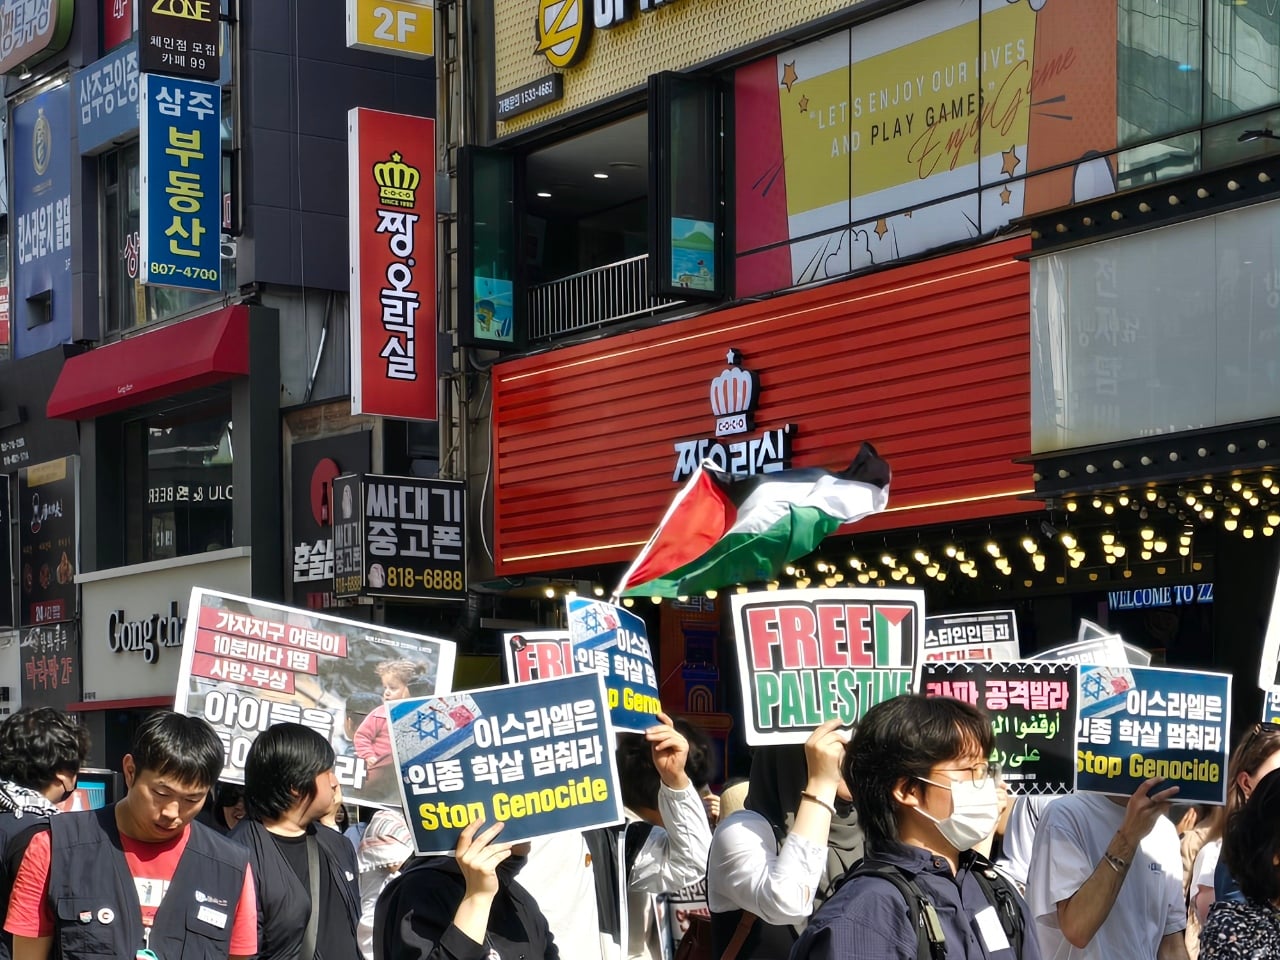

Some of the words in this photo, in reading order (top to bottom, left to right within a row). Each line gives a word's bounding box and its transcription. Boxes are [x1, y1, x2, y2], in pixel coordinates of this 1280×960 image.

[373, 7, 417, 43] 2F
[162, 53, 186, 68] 카페
[192, 42, 216, 57] 모집
[155, 86, 215, 121] 삼주
[869, 75, 925, 113] ENJOY
[932, 61, 968, 92] OUR
[871, 113, 914, 146] PLAY
[163, 126, 207, 258] 부동산
[151, 262, 219, 282] 807-4700
[366, 483, 461, 523] 싸대기
[367, 521, 463, 561] 중고폰
[387, 566, 463, 591] 818-6888
[1108, 586, 1173, 611] WELCOME
[1174, 584, 1195, 605] TO
[108, 609, 160, 664] Gong
[215, 611, 286, 642] 가자지구
[288, 626, 340, 654] 어린이
[746, 603, 873, 670] FREE
[212, 634, 285, 667] 10분마다
[285, 650, 311, 671] 1명
[613, 654, 644, 686] 학살
[1125, 688, 1223, 720] 이스라엘은
[472, 699, 599, 749] 이스라엘은
[1118, 717, 1162, 750] 학살
[1166, 723, 1222, 753] 멈춰라
[407, 758, 465, 796] 인종
[470, 749, 525, 787] 학살
[530, 735, 603, 778] 멈춰라
[1076, 749, 1122, 779] Stop
[1128, 751, 1221, 784] Genocide
[418, 801, 486, 832] Stop
[492, 775, 609, 824] Genocide
